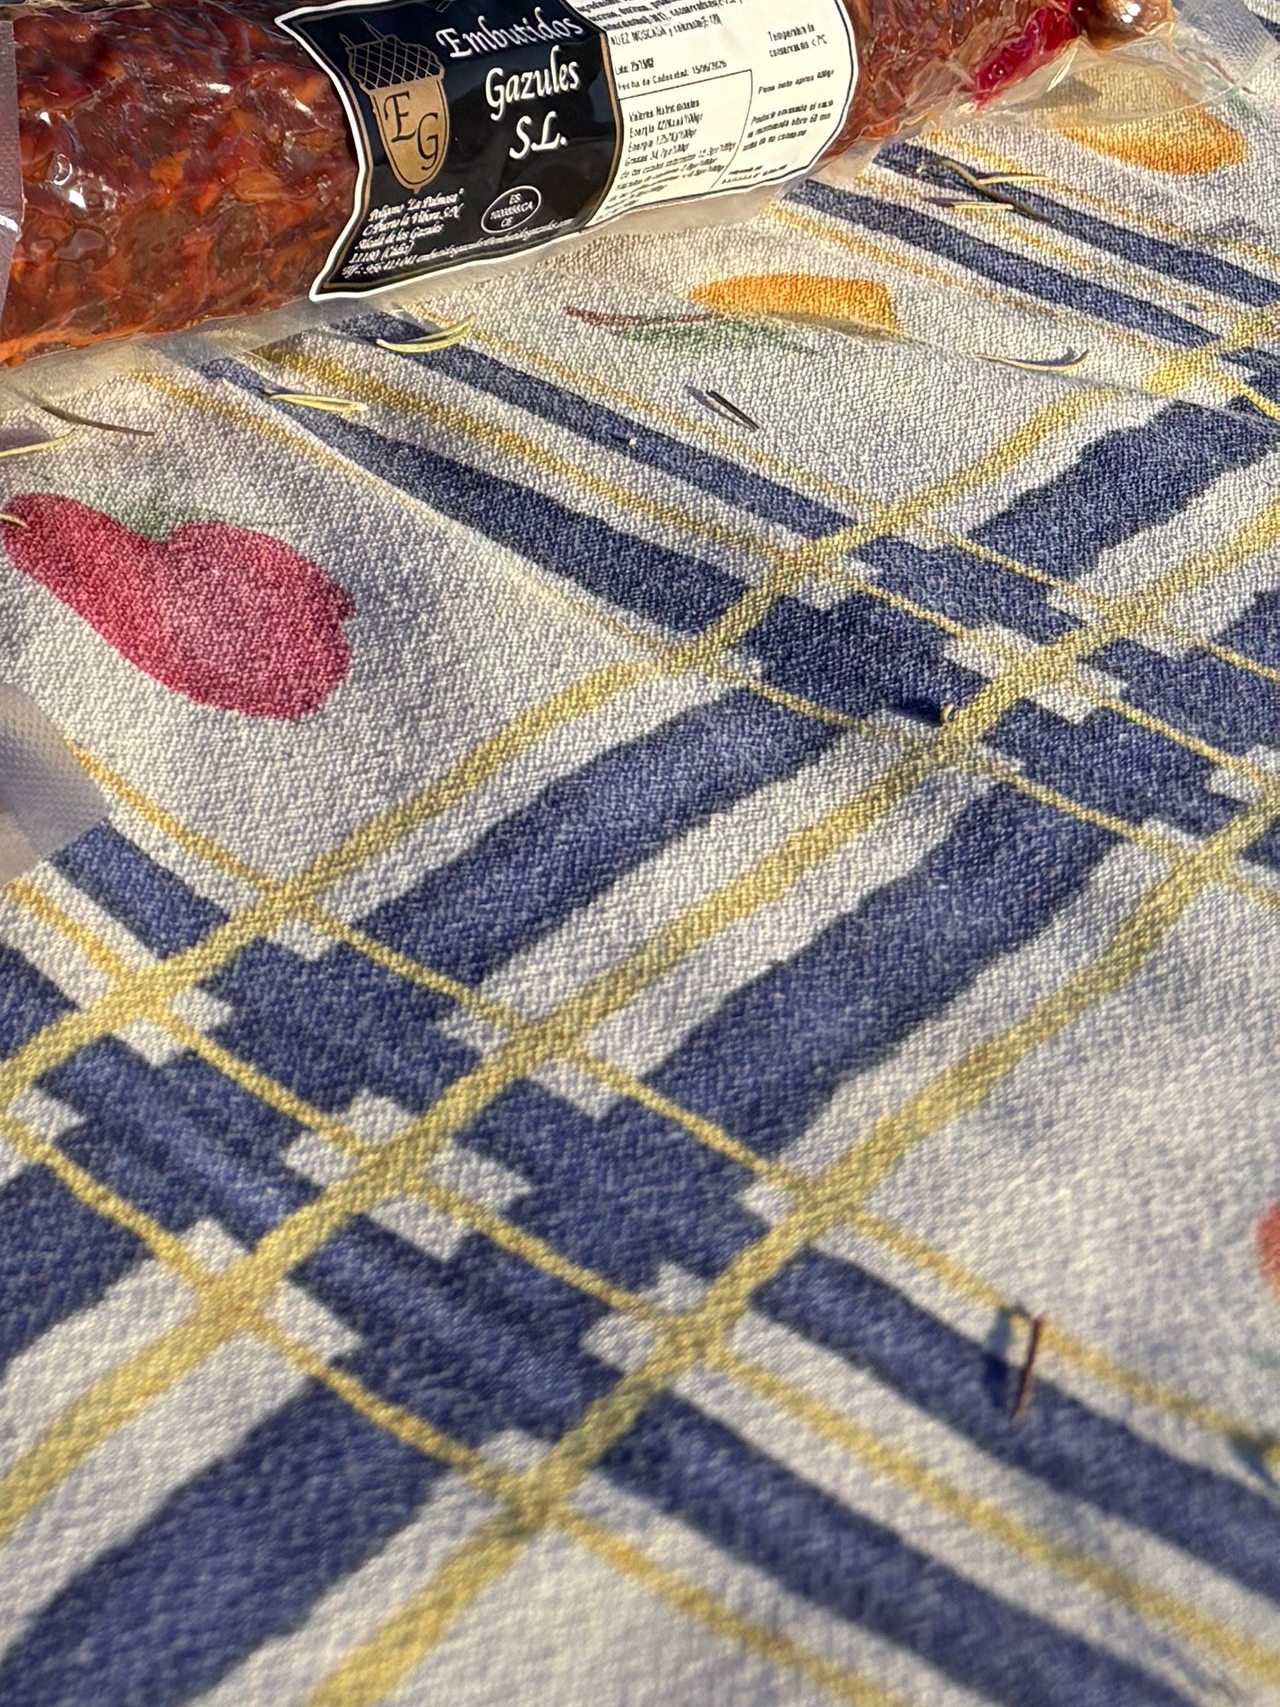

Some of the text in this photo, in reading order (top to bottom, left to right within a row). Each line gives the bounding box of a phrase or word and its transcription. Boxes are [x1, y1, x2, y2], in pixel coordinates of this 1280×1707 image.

[435, 5, 584, 59] Embutidos
[485, 44, 581, 122] Gazules
[509, 110, 568, 160] S.L.
